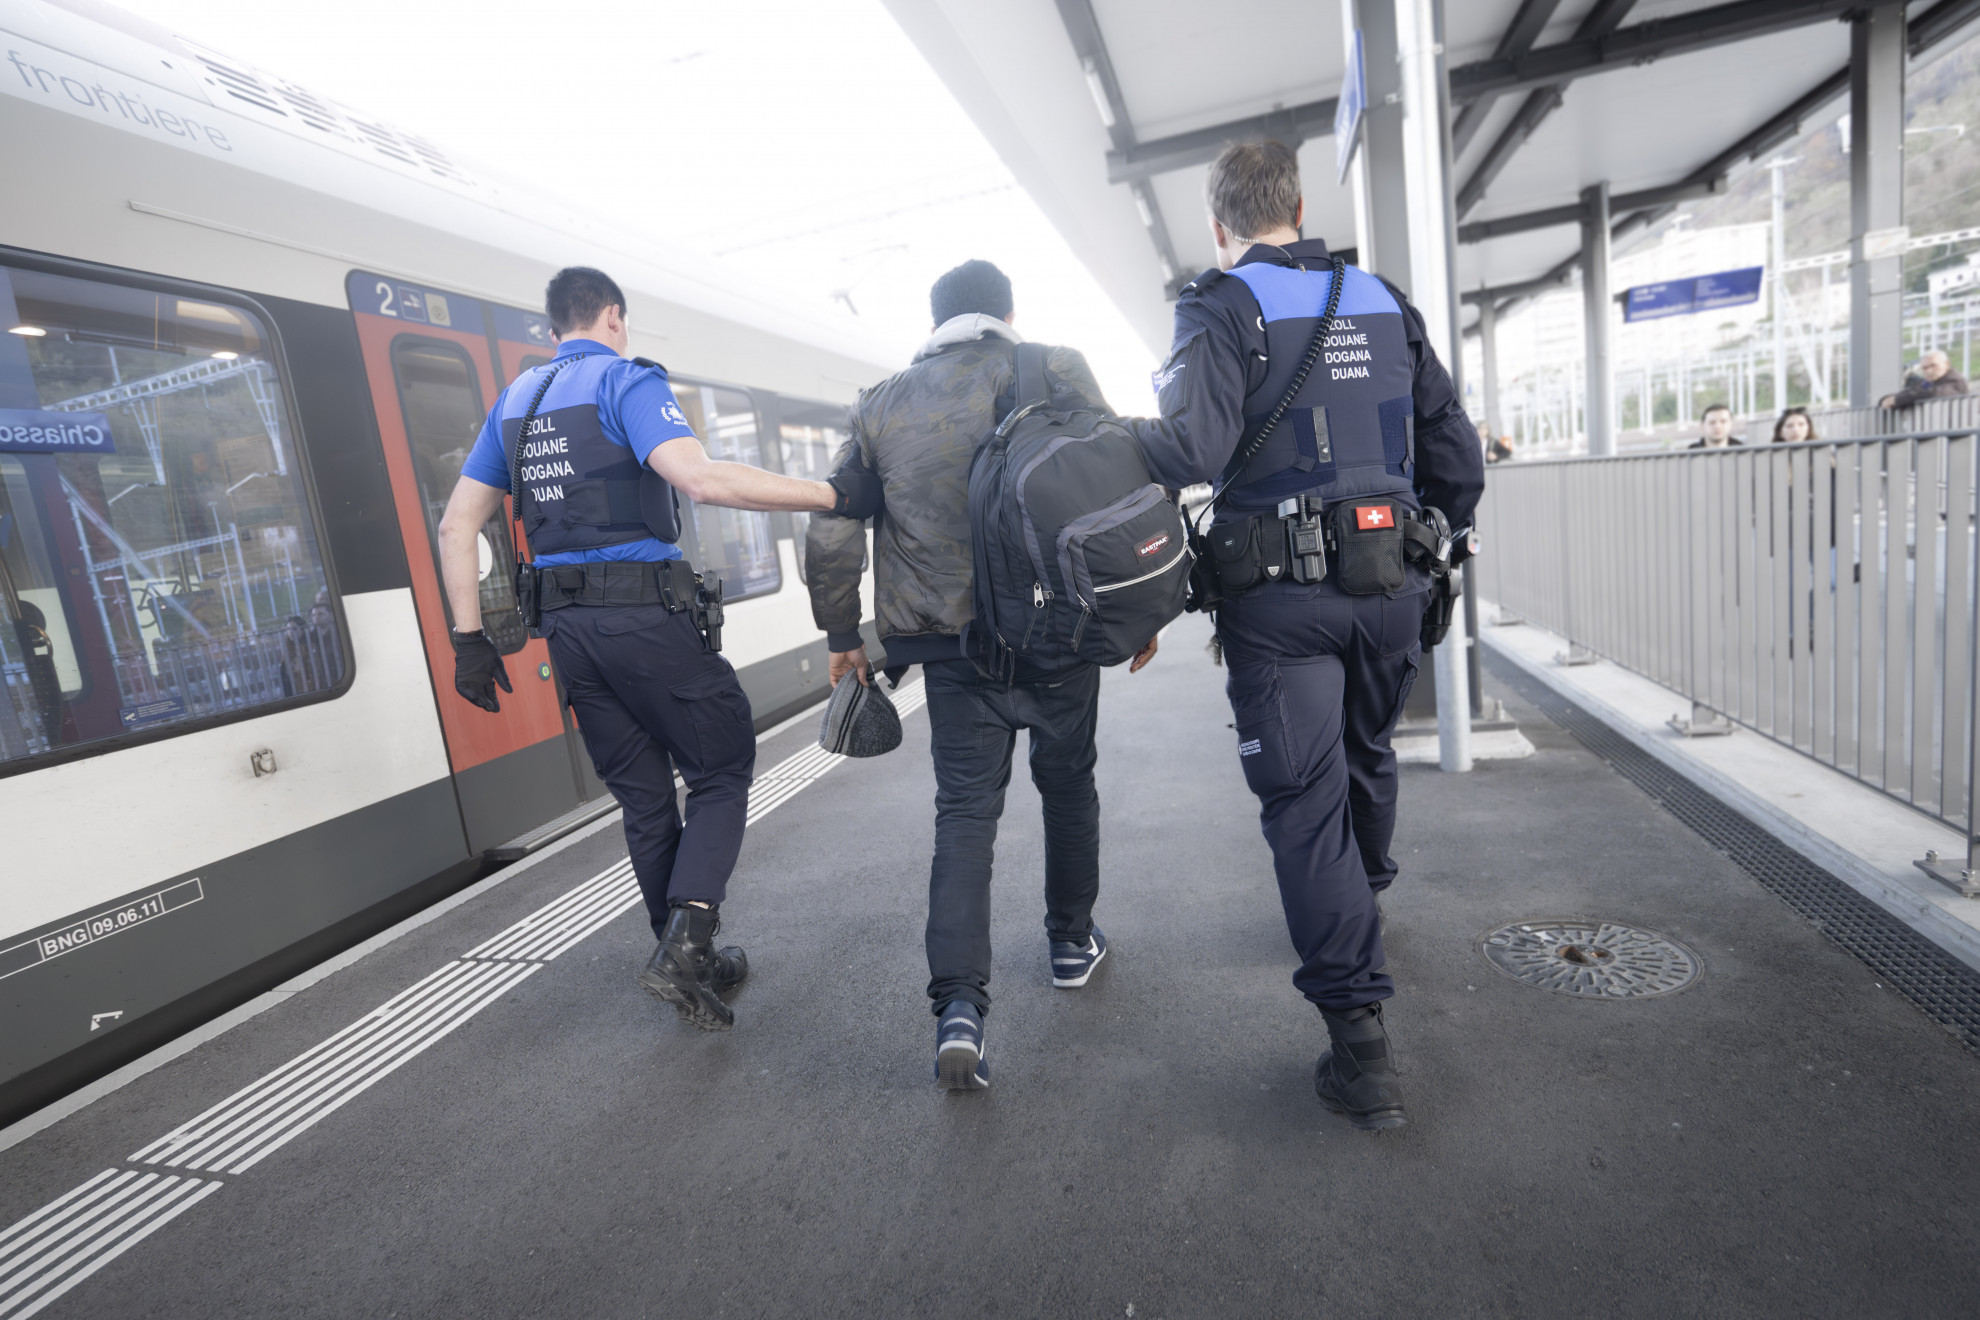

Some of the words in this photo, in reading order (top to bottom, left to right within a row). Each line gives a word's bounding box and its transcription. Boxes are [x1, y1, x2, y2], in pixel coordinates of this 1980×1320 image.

[7, 49, 233, 151] frontiere
[375, 281, 397, 317] 2
[1323, 333, 1368, 347] DOUANE
[1325, 350, 1371, 363] DOGANA
[1331, 366, 1369, 380] DUANA
[521, 460, 574, 481] DOGANA
[1141, 536, 1168, 554] EASTPAK
[43, 928, 88, 956] BNG
[92, 900, 159, 936] 09.06.11
